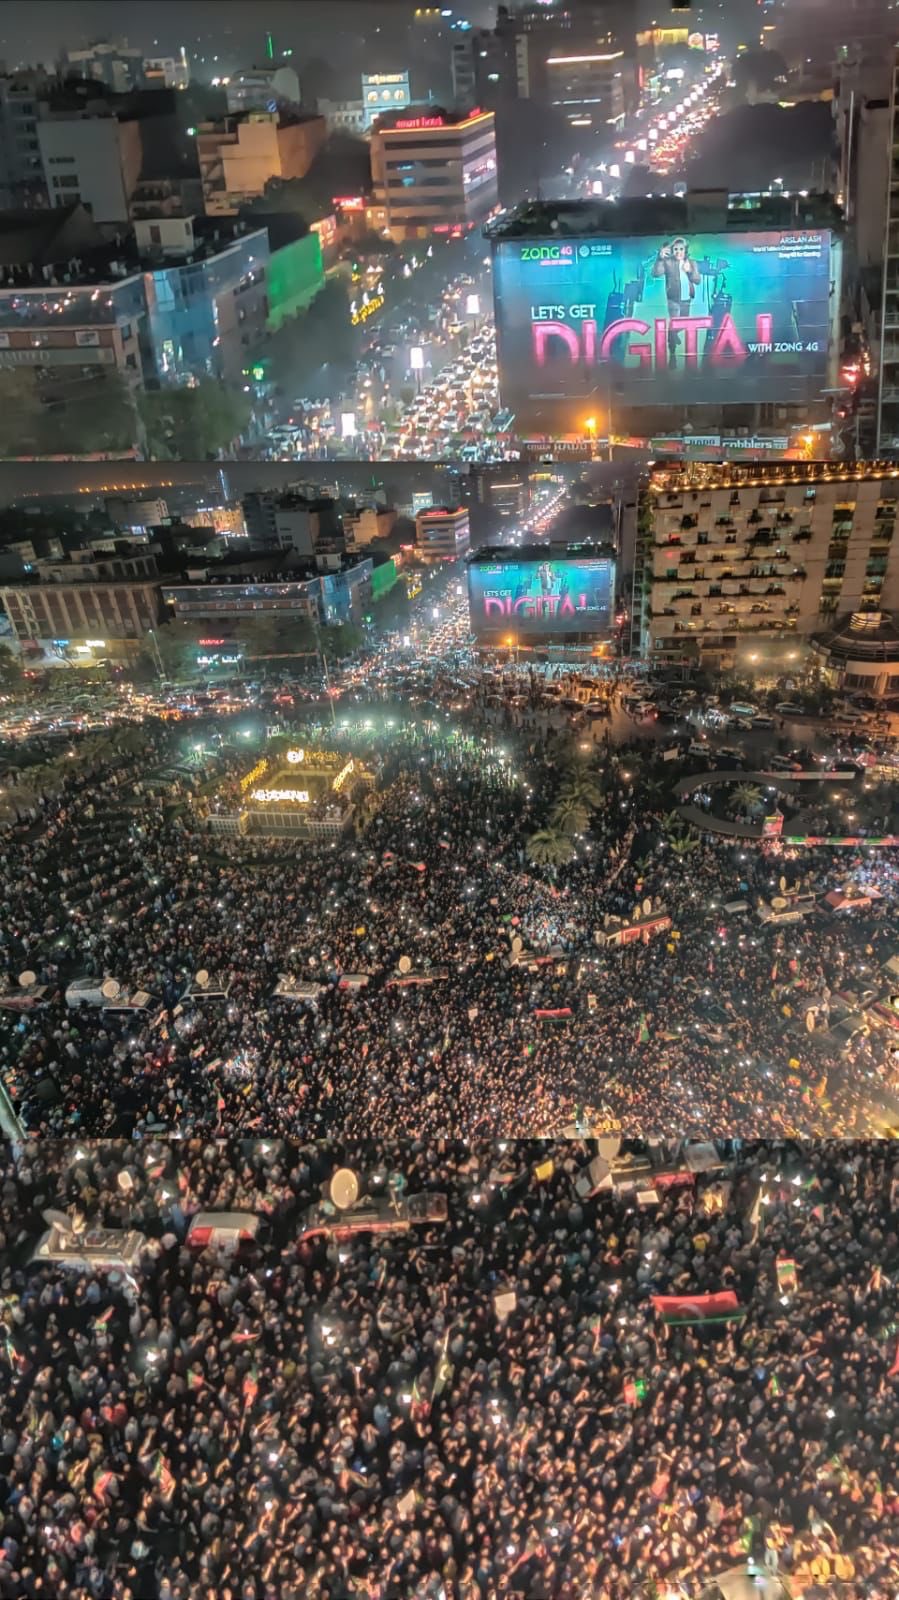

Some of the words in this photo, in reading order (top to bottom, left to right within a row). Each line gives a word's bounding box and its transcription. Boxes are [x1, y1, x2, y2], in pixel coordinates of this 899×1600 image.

[531, 305, 565, 320] LET'S
[569, 304, 596, 318] GET
[748, 343, 773, 353] WITH
[774, 342, 803, 352] ZONG
[806, 342, 819, 351] 4G
